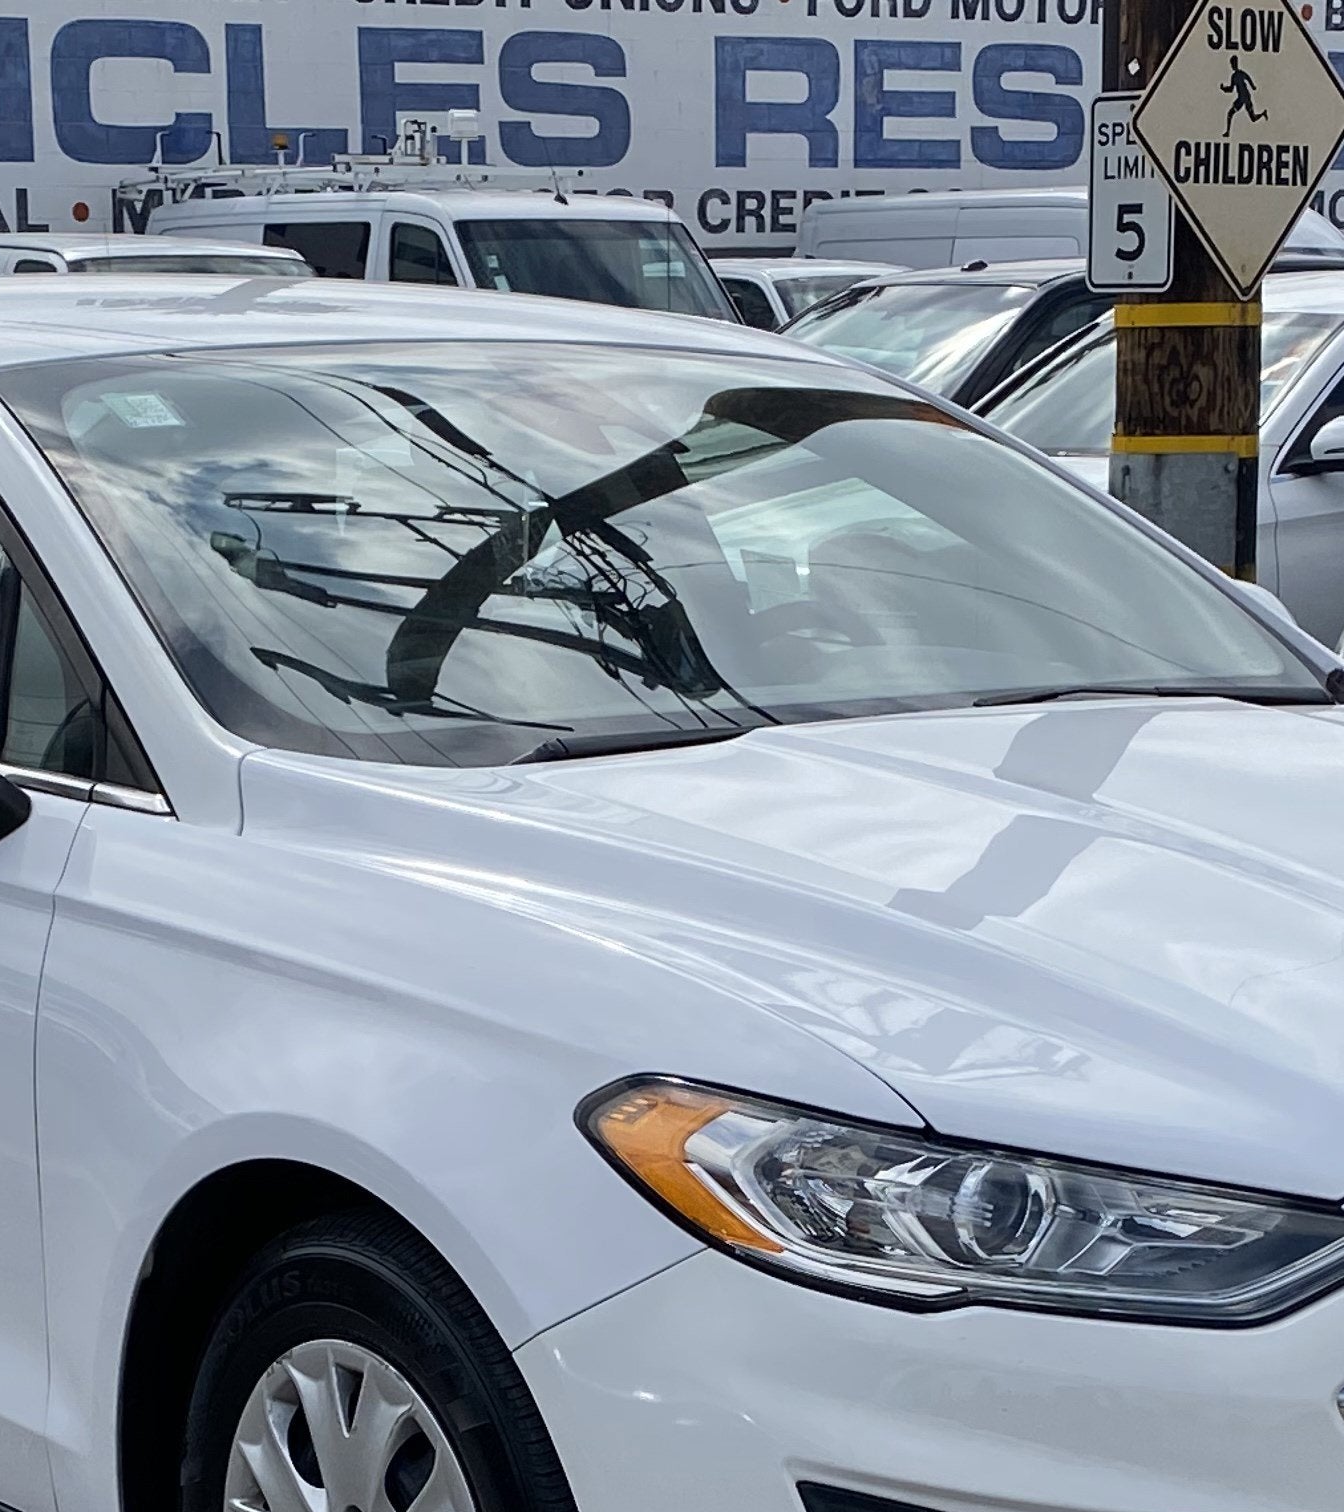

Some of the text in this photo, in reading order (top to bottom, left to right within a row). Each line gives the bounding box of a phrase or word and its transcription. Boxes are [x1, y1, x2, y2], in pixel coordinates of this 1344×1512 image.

[1207, 6, 1284, 53] SLOW
[1173, 140, 1309, 187] CHILDREN
[1114, 202, 1146, 262] 5
